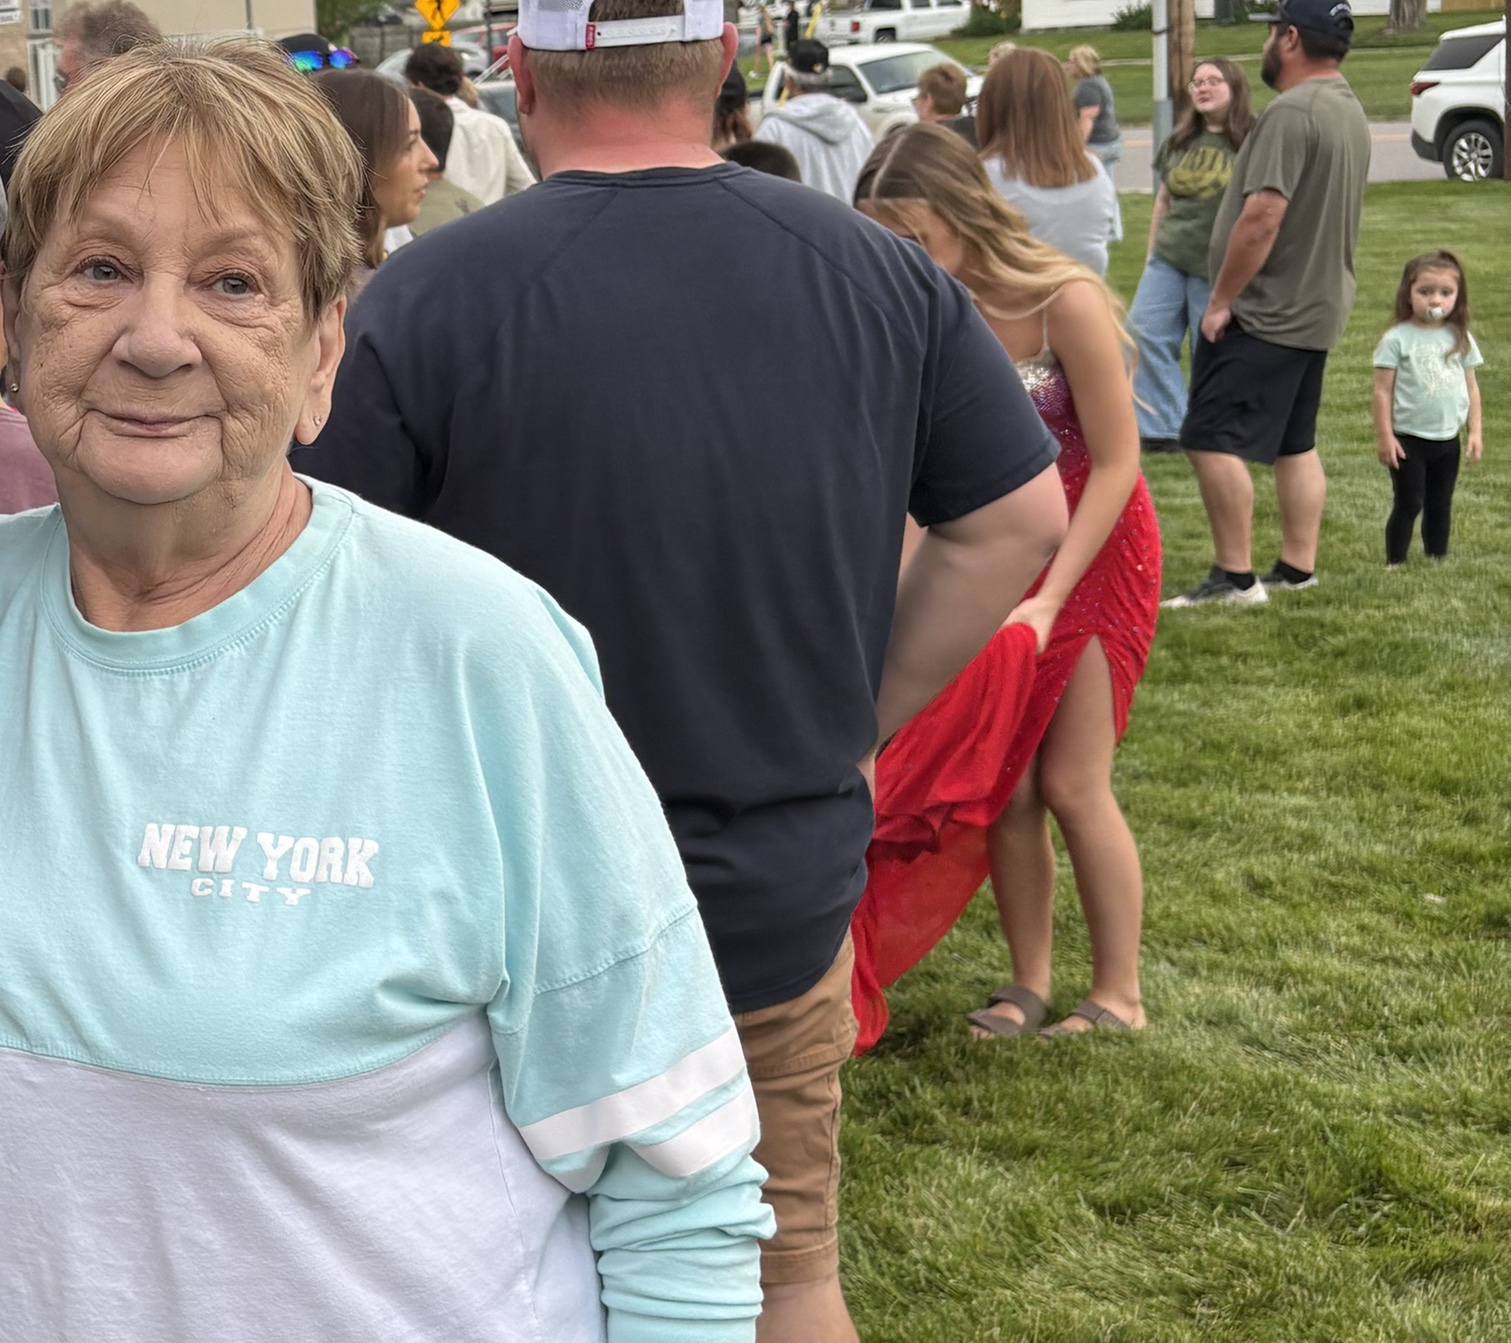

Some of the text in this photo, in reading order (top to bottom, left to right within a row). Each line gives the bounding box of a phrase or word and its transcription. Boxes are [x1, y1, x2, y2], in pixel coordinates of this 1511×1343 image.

[137, 823, 380, 889] NEW YORK
[191, 877, 311, 906] CITY
